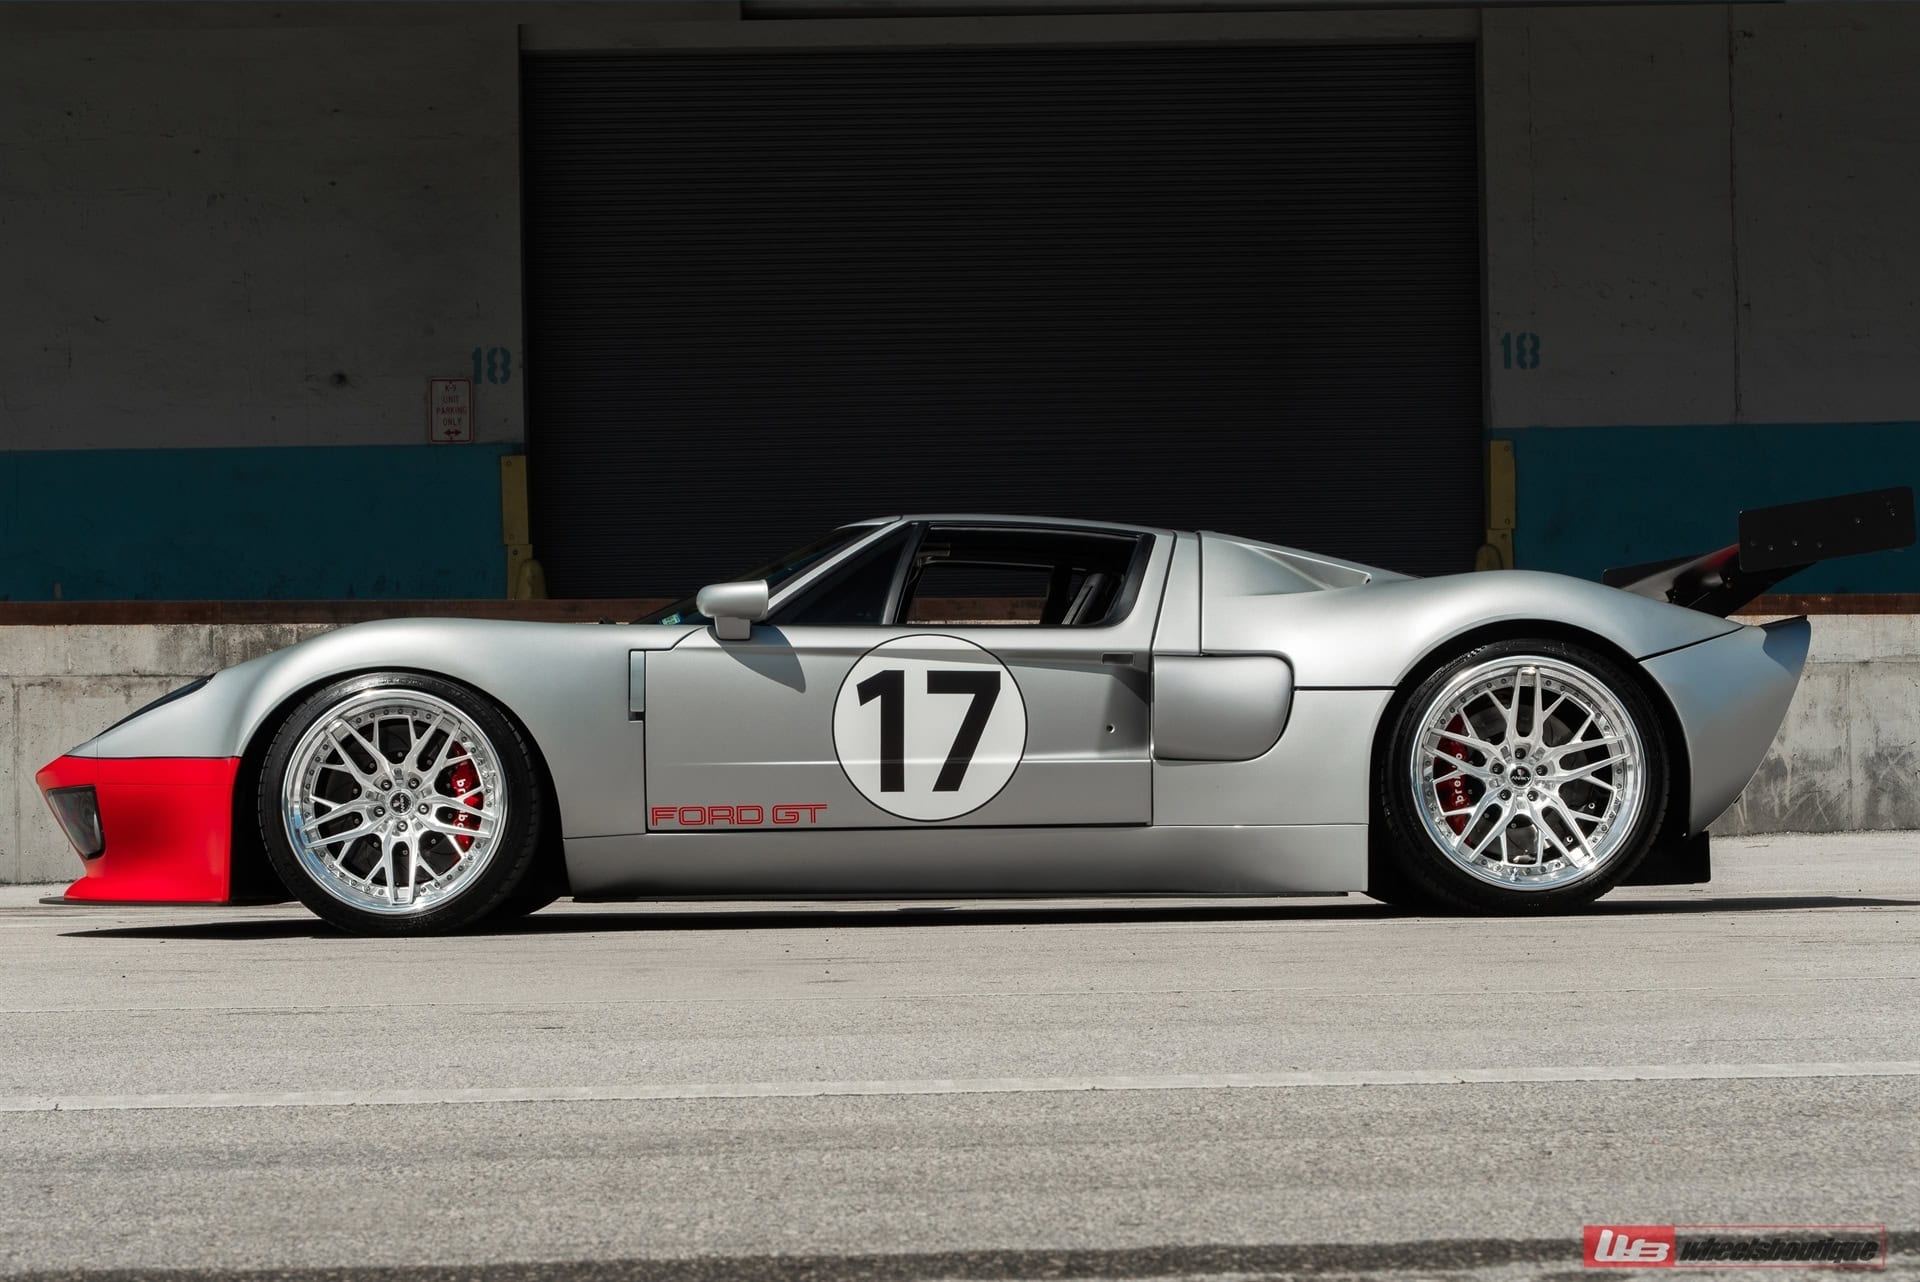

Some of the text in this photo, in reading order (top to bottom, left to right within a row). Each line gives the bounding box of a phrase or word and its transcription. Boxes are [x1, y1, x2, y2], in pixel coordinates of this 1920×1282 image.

[1501, 332, 1540, 369] 18
[472, 347, 511, 384] 18
[442, 395, 460, 404] UNIT
[445, 384, 457, 392] K-9
[436, 406, 466, 415] PARKING
[443, 417, 462, 426] ONLY
[856, 669, 1001, 793] 17
[1454, 753, 1466, 806] breo
[456, 779, 469, 828] brbo
[651, 804, 828, 826] FORD GT
